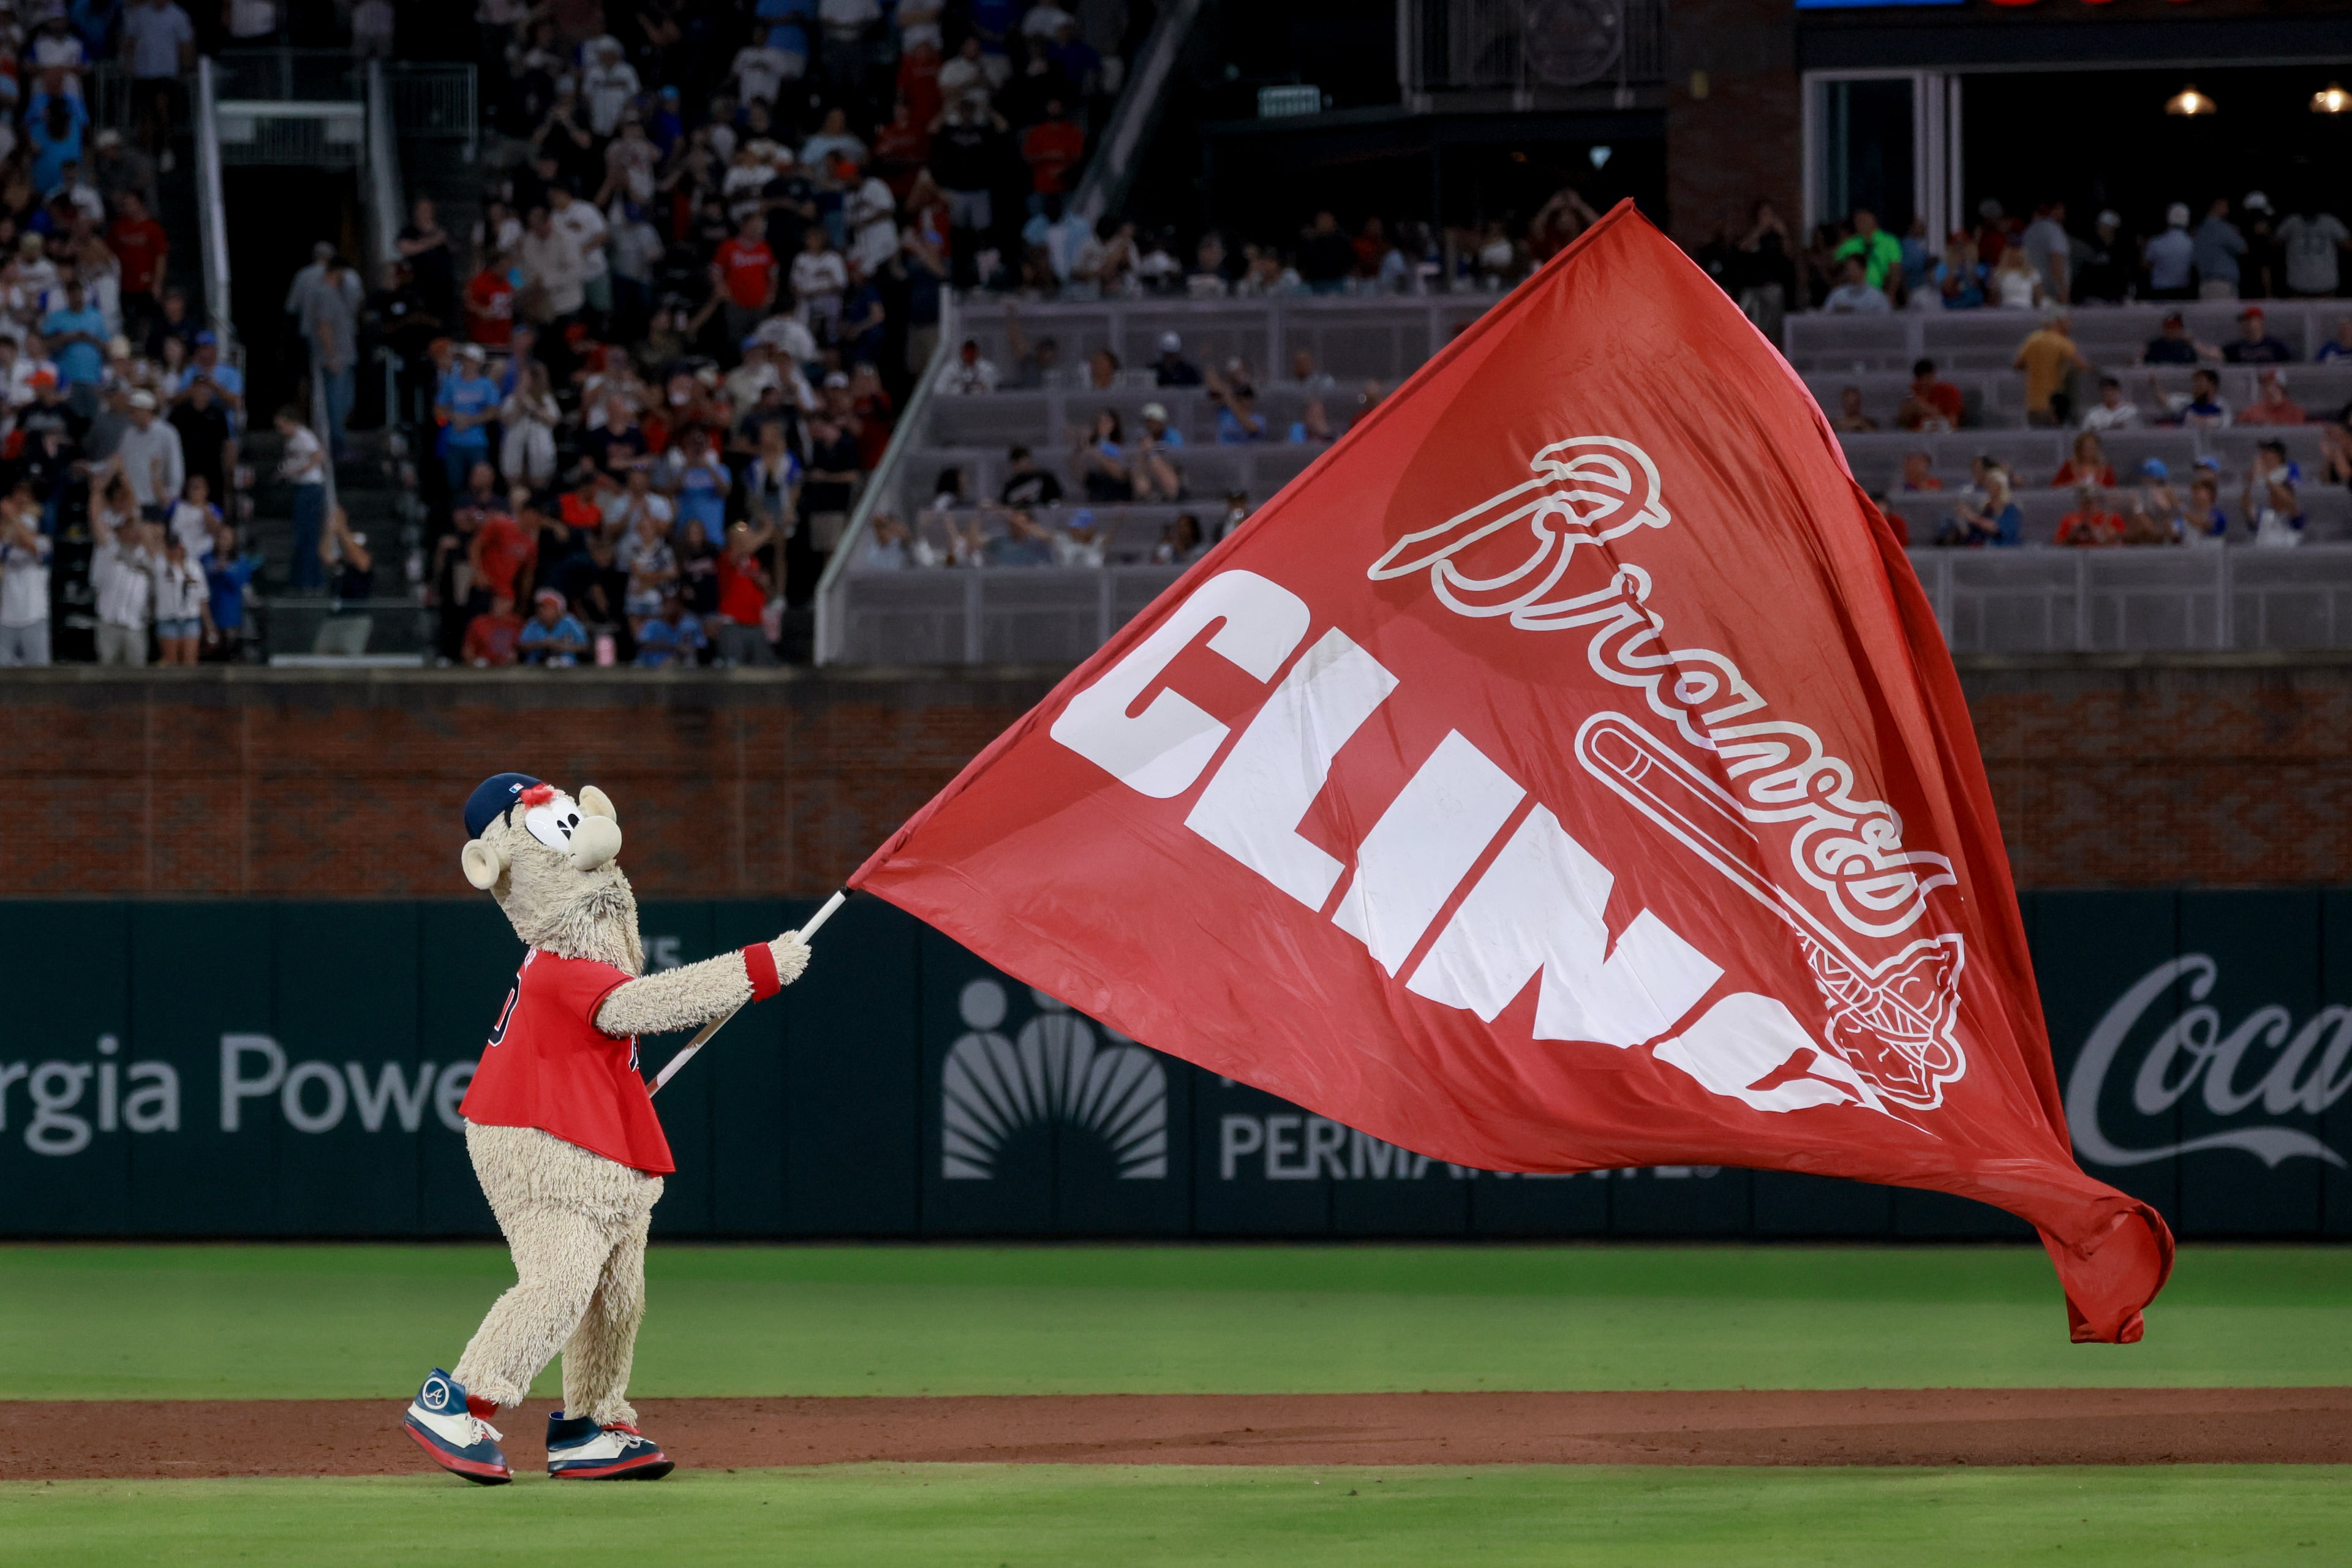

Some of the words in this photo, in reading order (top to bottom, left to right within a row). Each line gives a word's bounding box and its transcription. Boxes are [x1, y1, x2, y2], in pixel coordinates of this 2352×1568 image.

[1366, 435, 1958, 938] Braves
[221, 1033, 475, 1133] Powe
[2066, 952, 2352, 1169] Coca
